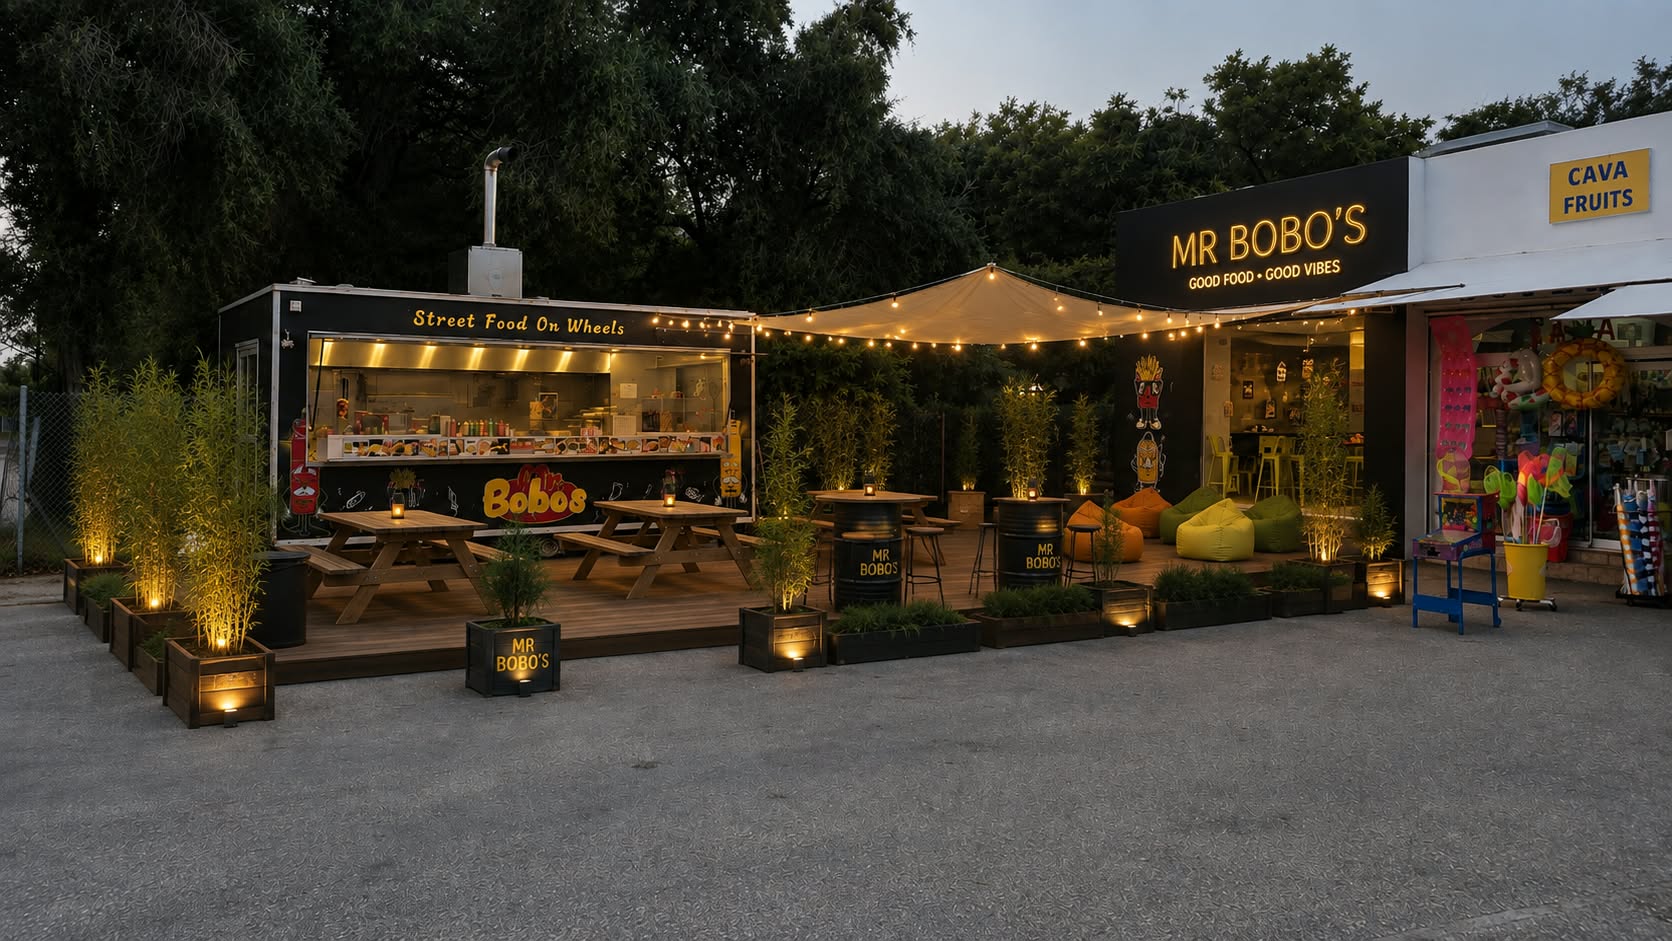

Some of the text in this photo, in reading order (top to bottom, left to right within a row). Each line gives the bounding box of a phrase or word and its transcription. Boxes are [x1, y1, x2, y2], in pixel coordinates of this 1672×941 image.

[1568, 161, 1628, 186] CAVA
[1563, 188, 1633, 214] FRUITS
[1172, 204, 1366, 269] MR BOBO'S
[1189, 259, 1341, 290] GOOD FOOD GOOD VIBES
[413, 310, 625, 336] Street Food On Wheels
[483, 478, 587, 518] Bobos
[872, 548, 890, 562] MR
[1037, 543, 1054, 556] MR
[512, 637, 535, 654] MR
[496, 653, 550, 672] BOBO'S
